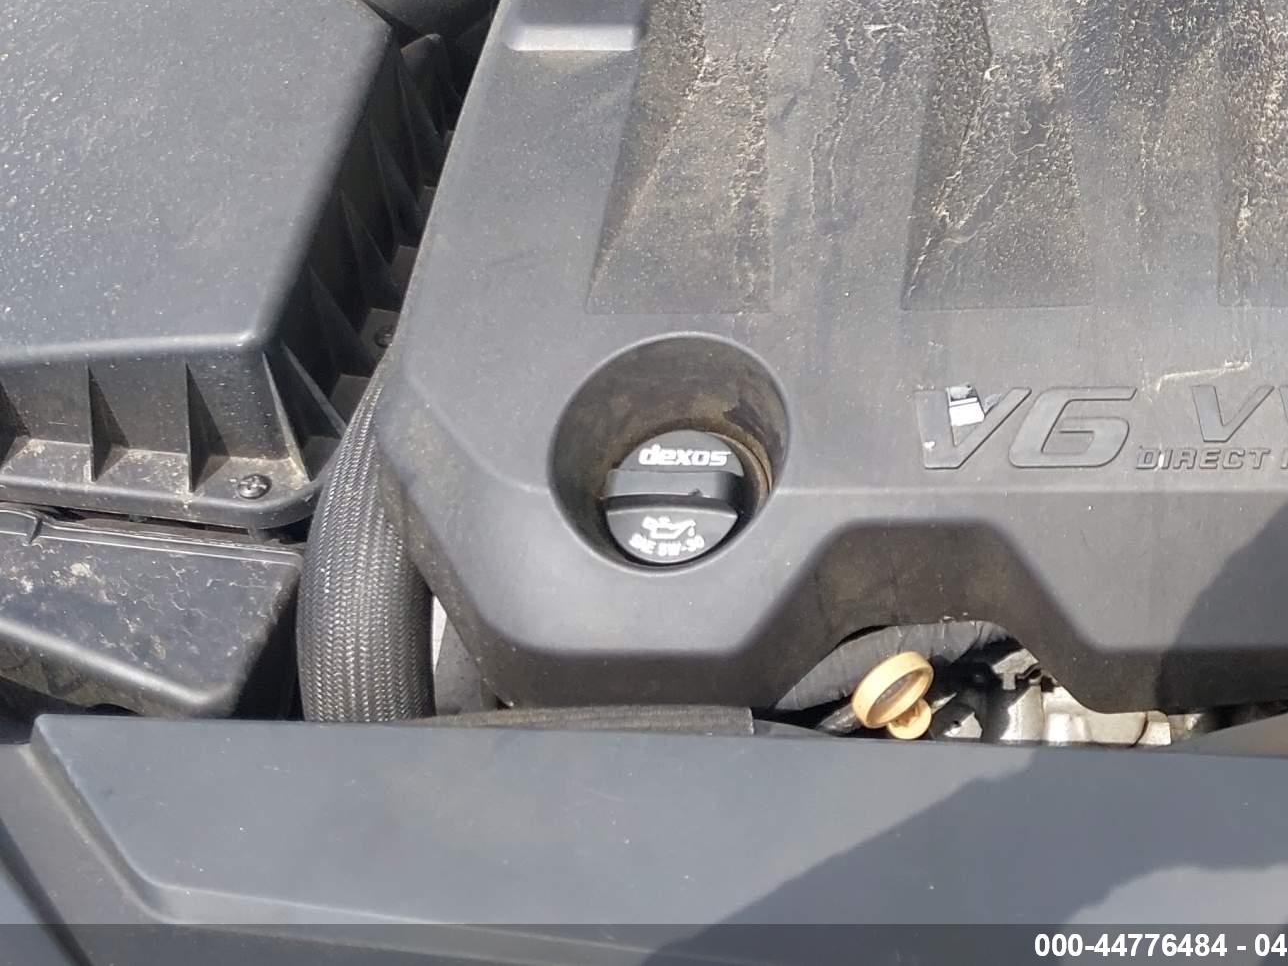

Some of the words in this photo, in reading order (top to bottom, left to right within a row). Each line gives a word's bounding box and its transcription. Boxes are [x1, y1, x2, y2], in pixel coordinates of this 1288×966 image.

[913, 385, 1138, 470] V6
[638, 444, 732, 467] dexos
[1135, 446, 1271, 470] DIRECT
